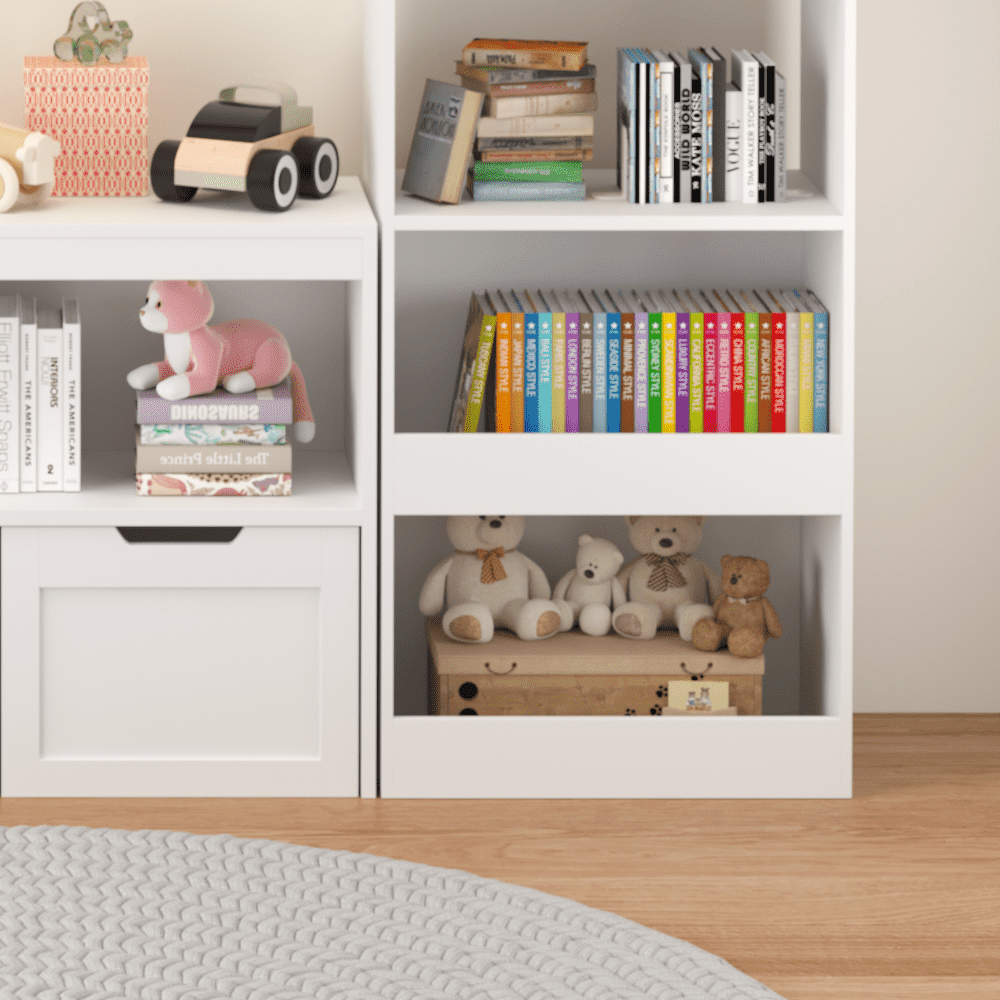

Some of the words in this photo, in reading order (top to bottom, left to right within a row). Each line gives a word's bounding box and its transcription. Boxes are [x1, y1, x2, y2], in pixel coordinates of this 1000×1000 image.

[747, 66, 755, 96] TELLER
[682, 88, 690, 134] WORLD
[692, 92, 702, 134] MOSS
[747, 98, 755, 128] STORY
[682, 140, 690, 171] WILD
[692, 137, 702, 177] KATE
[727, 119, 740, 173] VOGUE
[747, 130, 755, 168] WALKER
[747, 170, 755, 186] TIM
[499, 338, 509, 366] INDIAN
[512, 338, 522, 366] JAPAN
[526, 338, 536, 370] MEXICO
[540, 338, 550, 357] BALI
[568, 338, 577, 373] LONDON
[582, 338, 591, 368] BERLIN
[609, 338, 619, 372] SEASIDE
[623, 338, 633, 374] MINIMAL
[637, 338, 646, 382] PROVENCE
[650, 338, 660, 370] SYDNEY
[678, 338, 688, 370] LUXURY
[719, 338, 729, 366] RETRO
[733, 338, 743, 364] CHINA
[761, 338, 771, 374] AFRICAN
[815, 338, 825, 358] NEW
[540, 359, 550, 383] STYLE
[692, 338, 702, 386] CALIFORNIA
[705, 338, 715, 384] ECCENTRIC
[774, 338, 784, 386] MOROCCAN
[815, 360, 825, 382] YORK
[50, 357, 58, 408] INTERIORS
[499, 368, 509, 393] STYLE
[512, 368, 522, 393] STYLE
[526, 372, 536, 397] STYLE
[554, 364, 564, 389] STYLE
[568, 375, 577, 400] STYLE
[582, 369, 591, 394] STYLE
[596, 375, 605, 400] STYLE
[609, 374, 619, 399] STYLE
[623, 375, 633, 401] STYLE
[650, 372, 660, 397] STYLE
[678, 371, 688, 397] STYLE
[719, 367, 729, 393] STYLE
[733, 366, 743, 391] STYLE
[761, 375, 771, 400] STYLE
[470, 379, 484, 405] STYLE
[637, 383, 646, 408] STYLE
[692, 388, 702, 412] STYLE
[705, 385, 715, 411] STYLE
[747, 379, 757, 403] STYLE
[774, 388, 784, 413] STYLE
[815, 383, 825, 409] STYLE
[664, 400, 674, 424] STYLE
